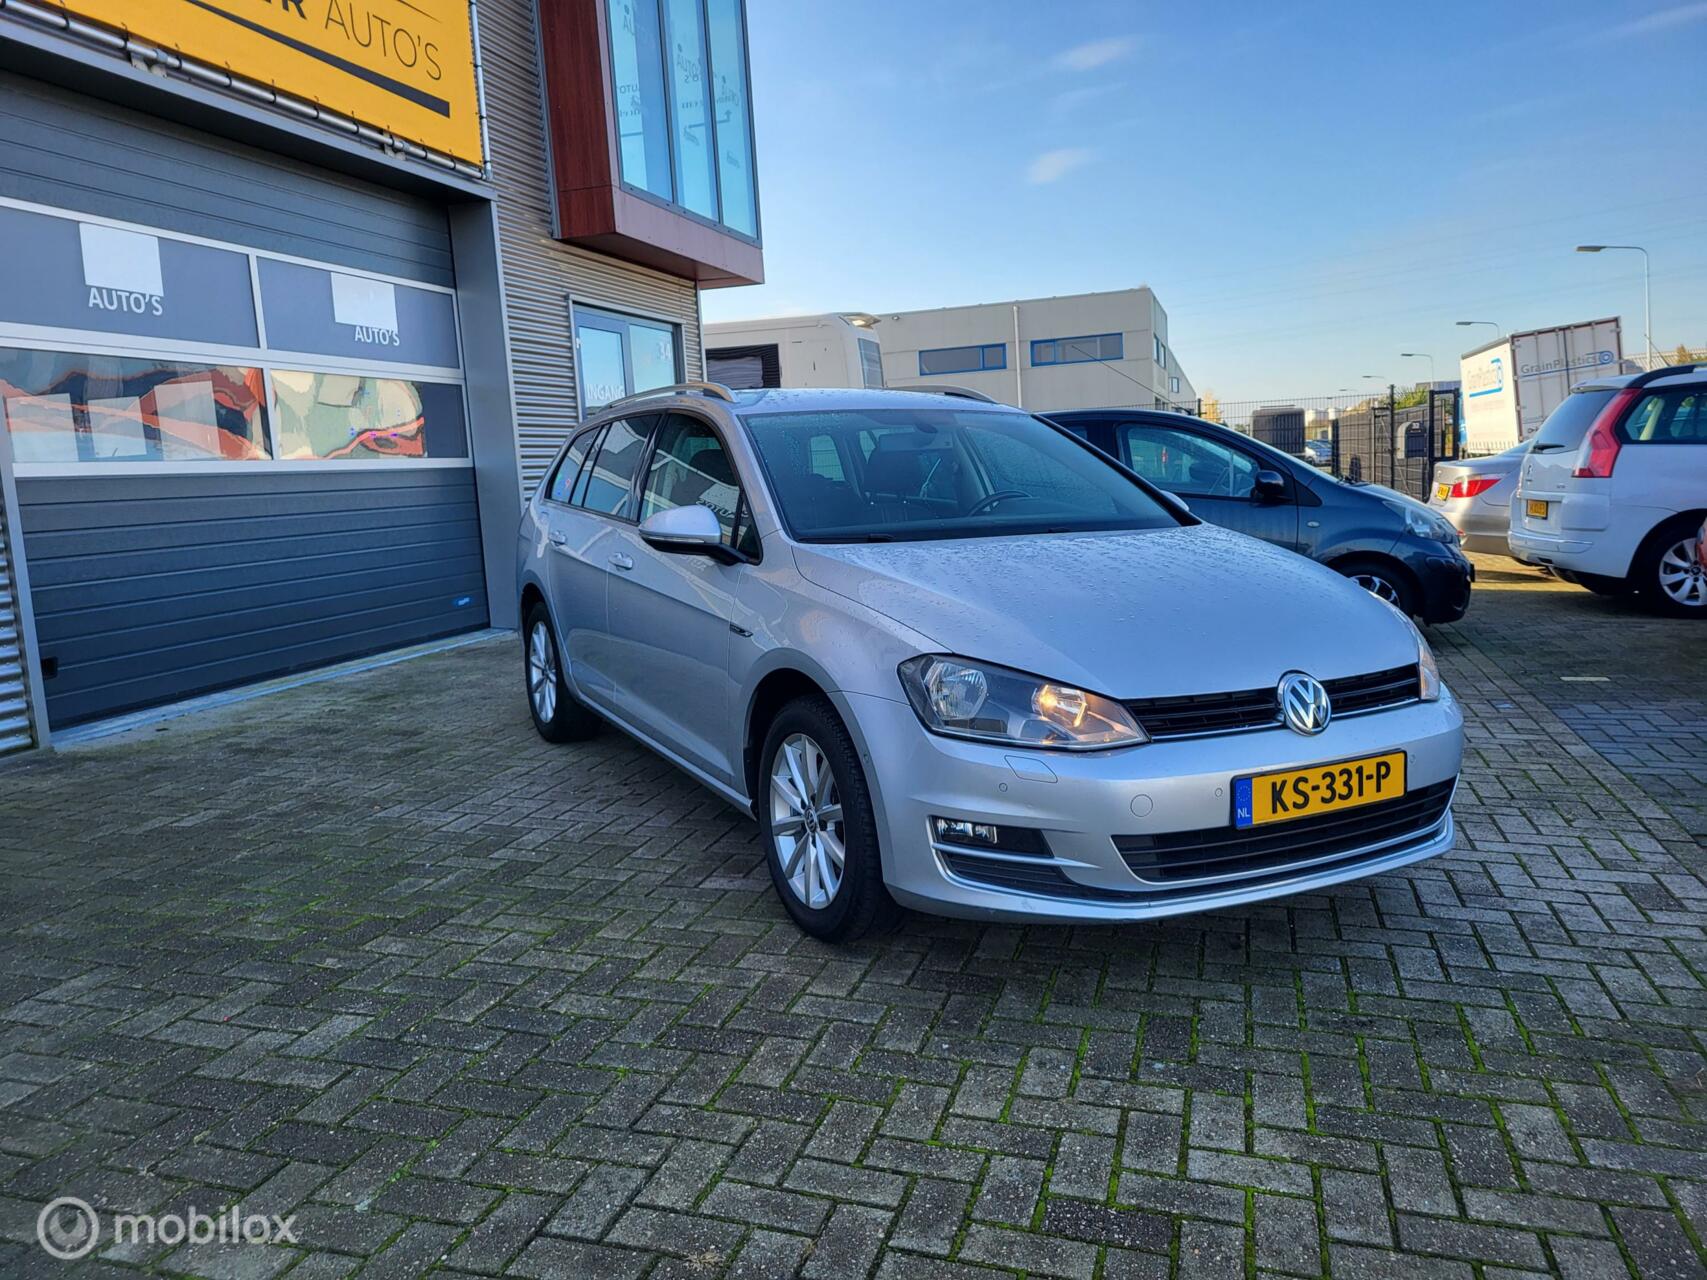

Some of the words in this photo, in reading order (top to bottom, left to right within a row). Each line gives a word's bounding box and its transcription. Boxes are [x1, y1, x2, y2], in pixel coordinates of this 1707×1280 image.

[324, 0, 442, 81] AUTO'S
[88, 286, 163, 316] AUTO'S
[354, 325, 400, 346] AUTO'S
[1271, 760, 1391, 814] KS-331-P
[1237, 807, 1250, 818] NL
